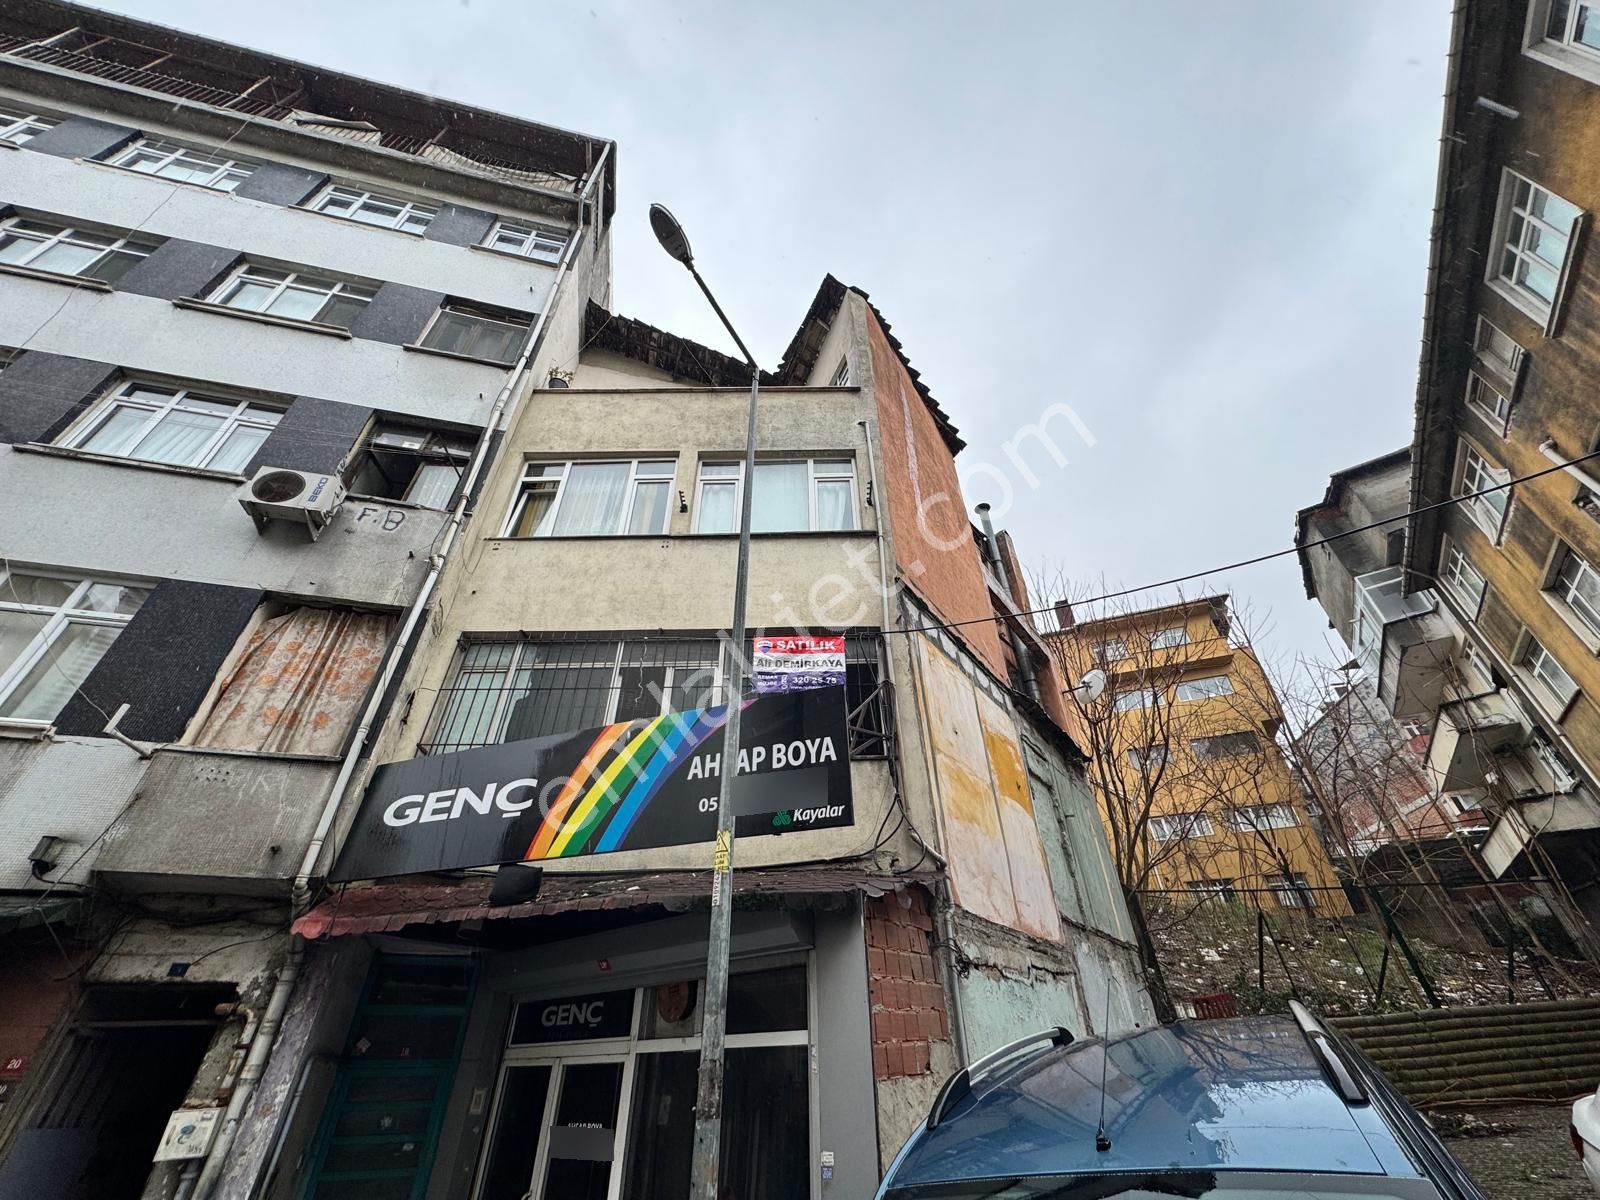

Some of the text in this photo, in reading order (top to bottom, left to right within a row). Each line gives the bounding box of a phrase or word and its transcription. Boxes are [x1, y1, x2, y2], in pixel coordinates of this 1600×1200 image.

[307, 477, 329, 503] BEKO
[776, 640, 835, 650] SATILIK
[792, 676, 809, 684] 320
[687, 736, 837, 780] AHAP BOYA
[383, 777, 538, 827] GENÇ
[793, 804, 846, 823] Kayalar
[541, 1001, 604, 1027] GENÇ
[7, 1059, 21, 1069] 20
